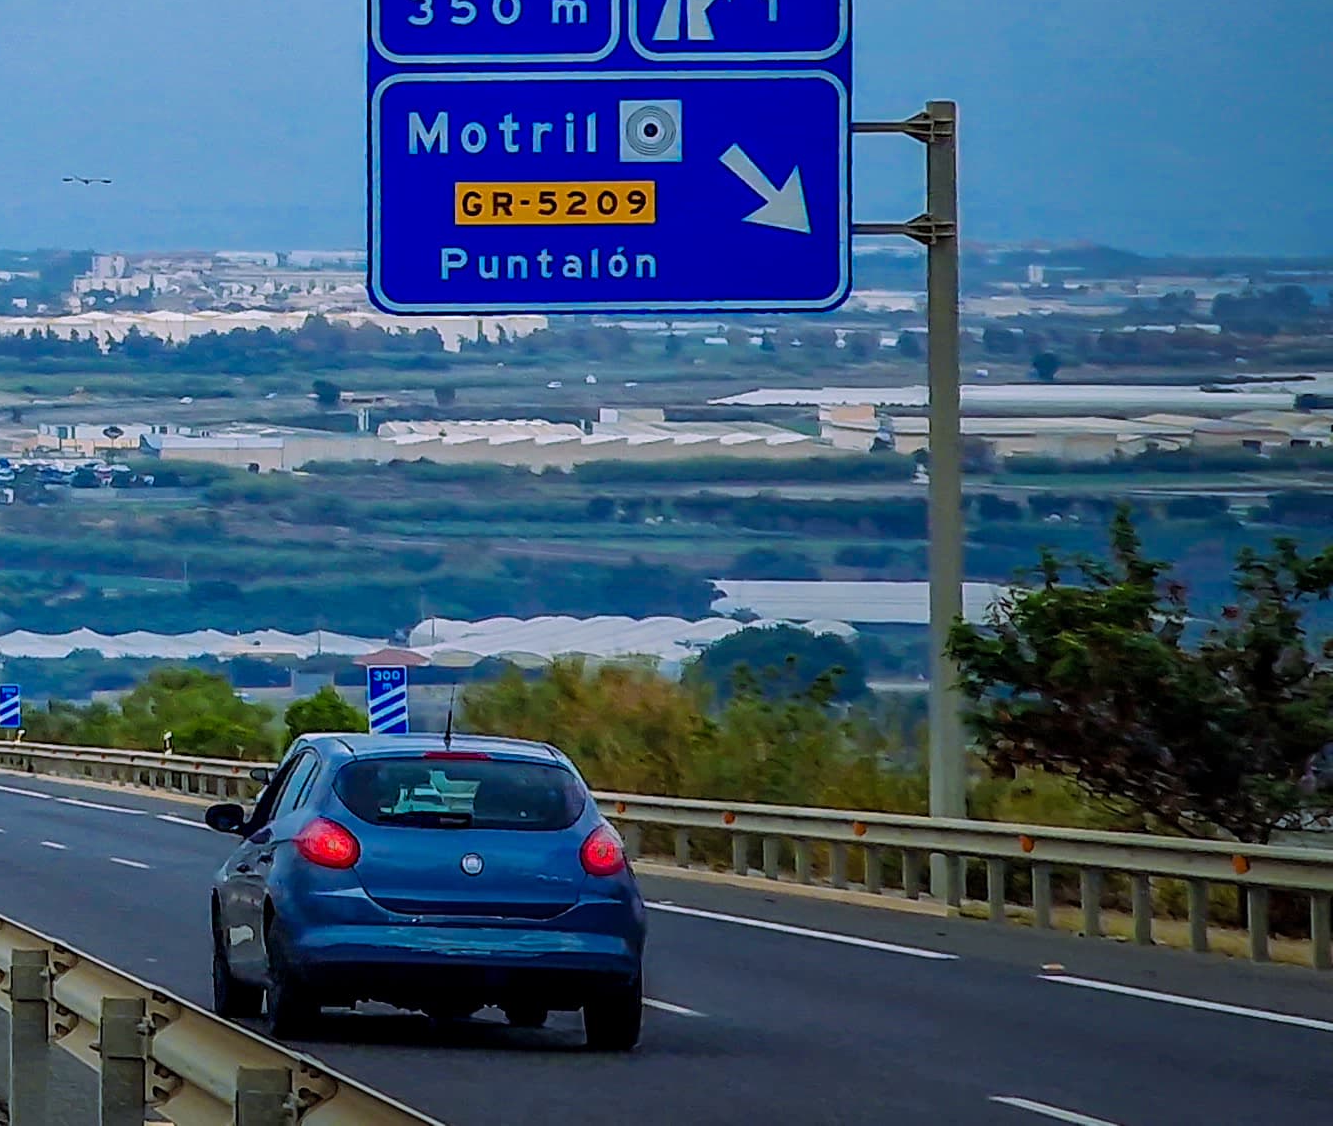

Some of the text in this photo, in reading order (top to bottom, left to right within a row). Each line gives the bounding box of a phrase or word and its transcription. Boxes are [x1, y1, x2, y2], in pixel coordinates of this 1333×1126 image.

[407, 110, 598, 155] Motril
[460, 189, 648, 218] GR-5209
[440, 245, 658, 280] Puntalón
[373, 670, 401, 681] 300
[382, 682, 393, 691] m
